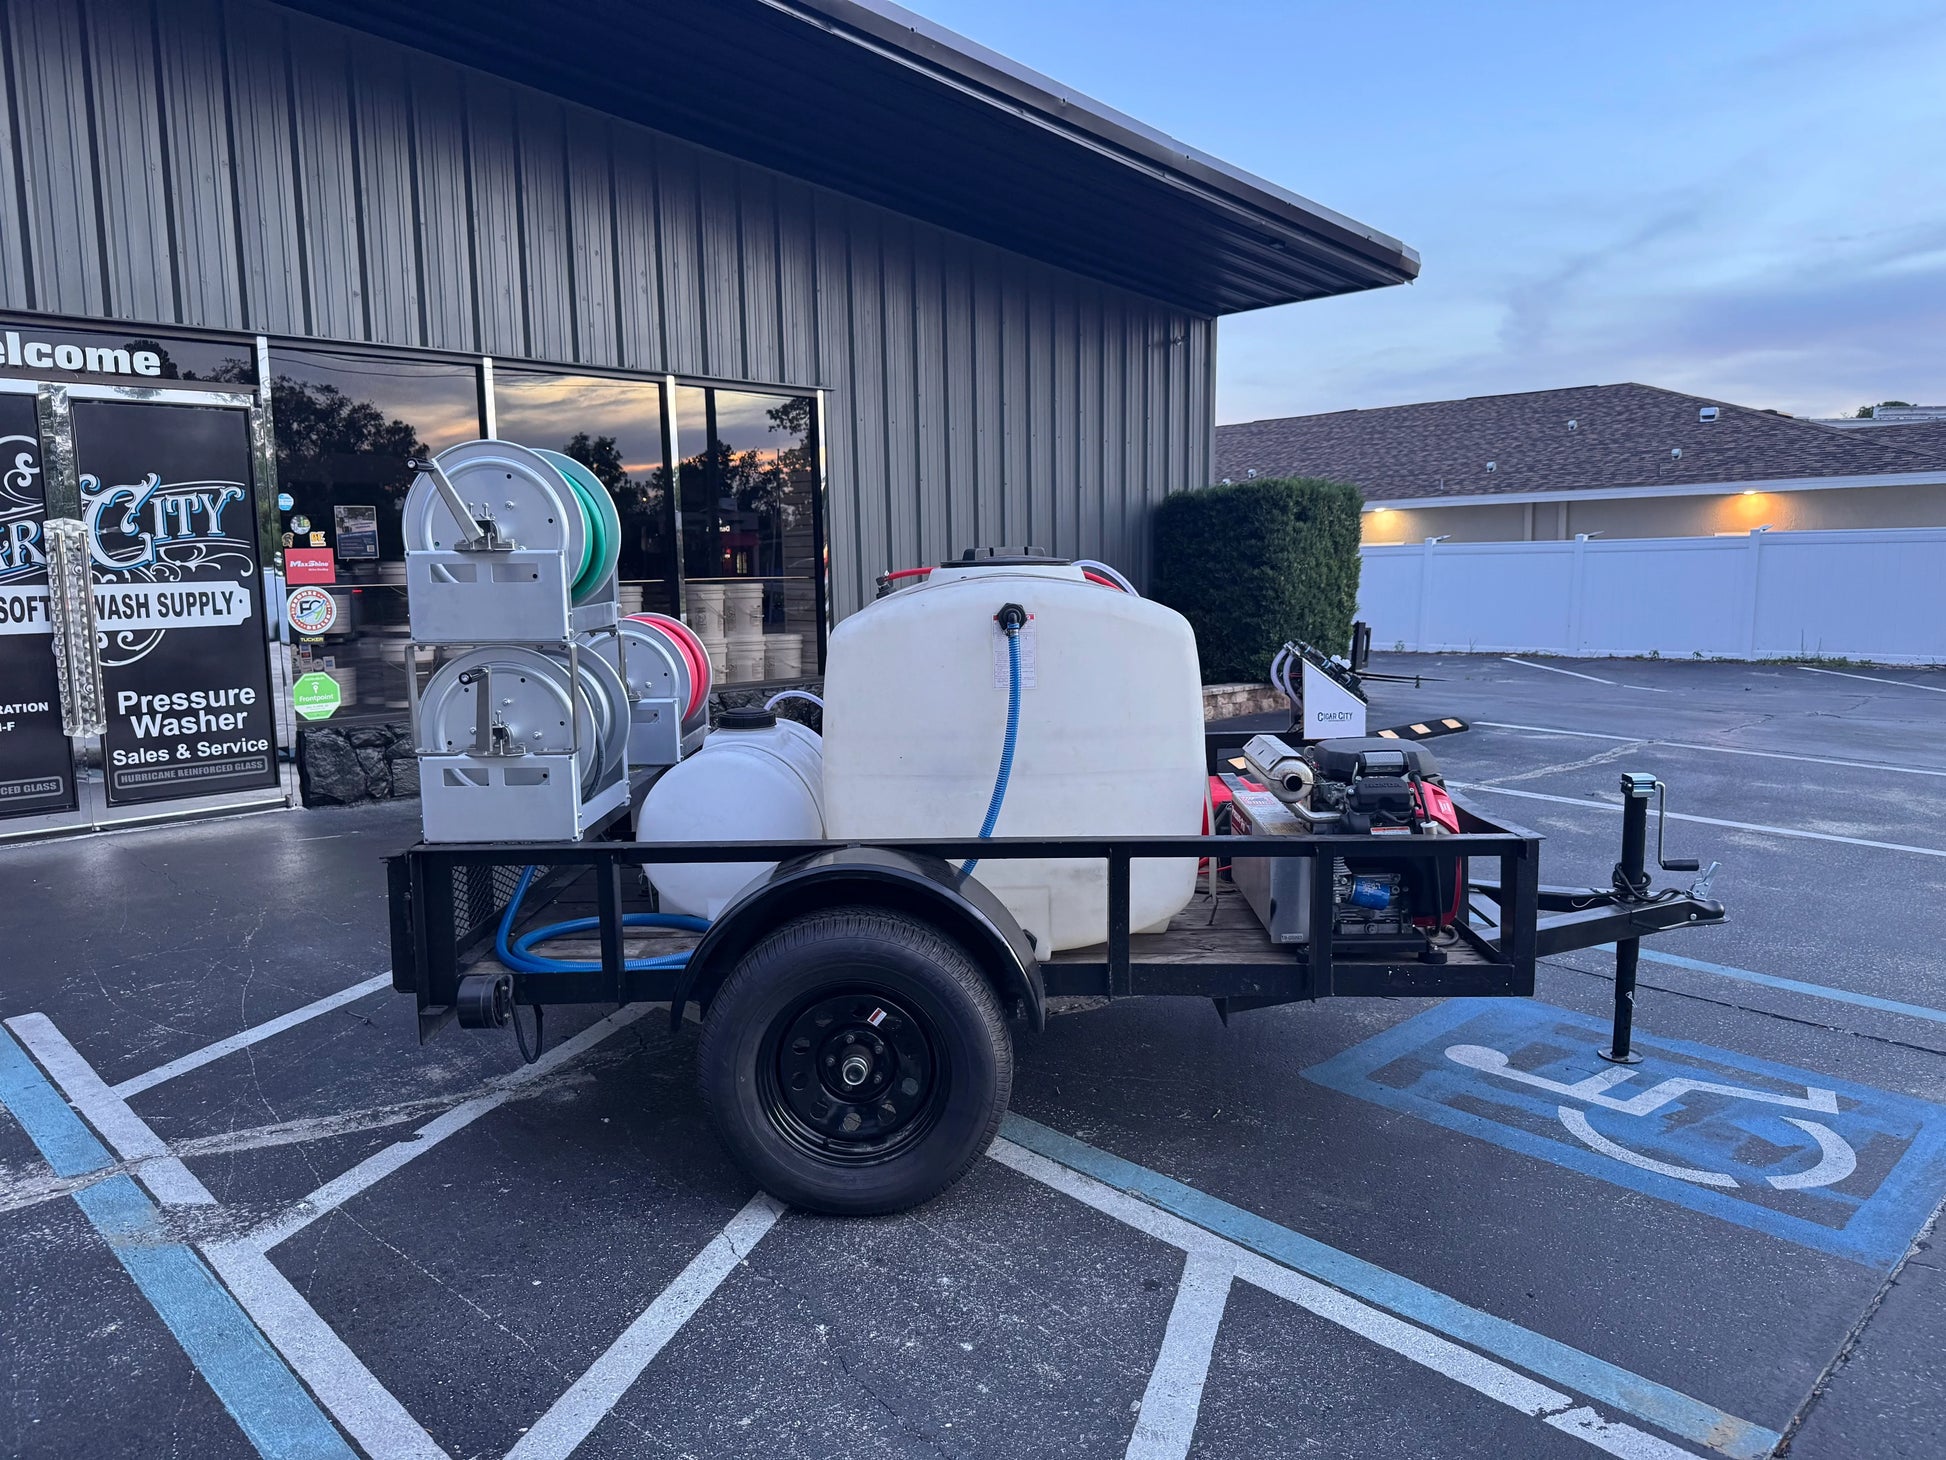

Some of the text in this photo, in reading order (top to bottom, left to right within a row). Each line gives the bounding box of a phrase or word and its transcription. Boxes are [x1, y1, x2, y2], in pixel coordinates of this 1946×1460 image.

[0, 331, 161, 376] lcome
[81, 473, 245, 571] CITY
[157, 591, 234, 618] SUPPLY
[117, 687, 256, 715] Pressure
[299, 694, 334, 703] Frontpoint
[130, 710, 248, 739] Washer
[1317, 712, 1353, 721] CIGAR CITY
[112, 737, 269, 766] Sales & Service
[121, 760, 264, 784] HURRICANE REINFORCED GLASS
[23, 782, 57, 793] GLASS
